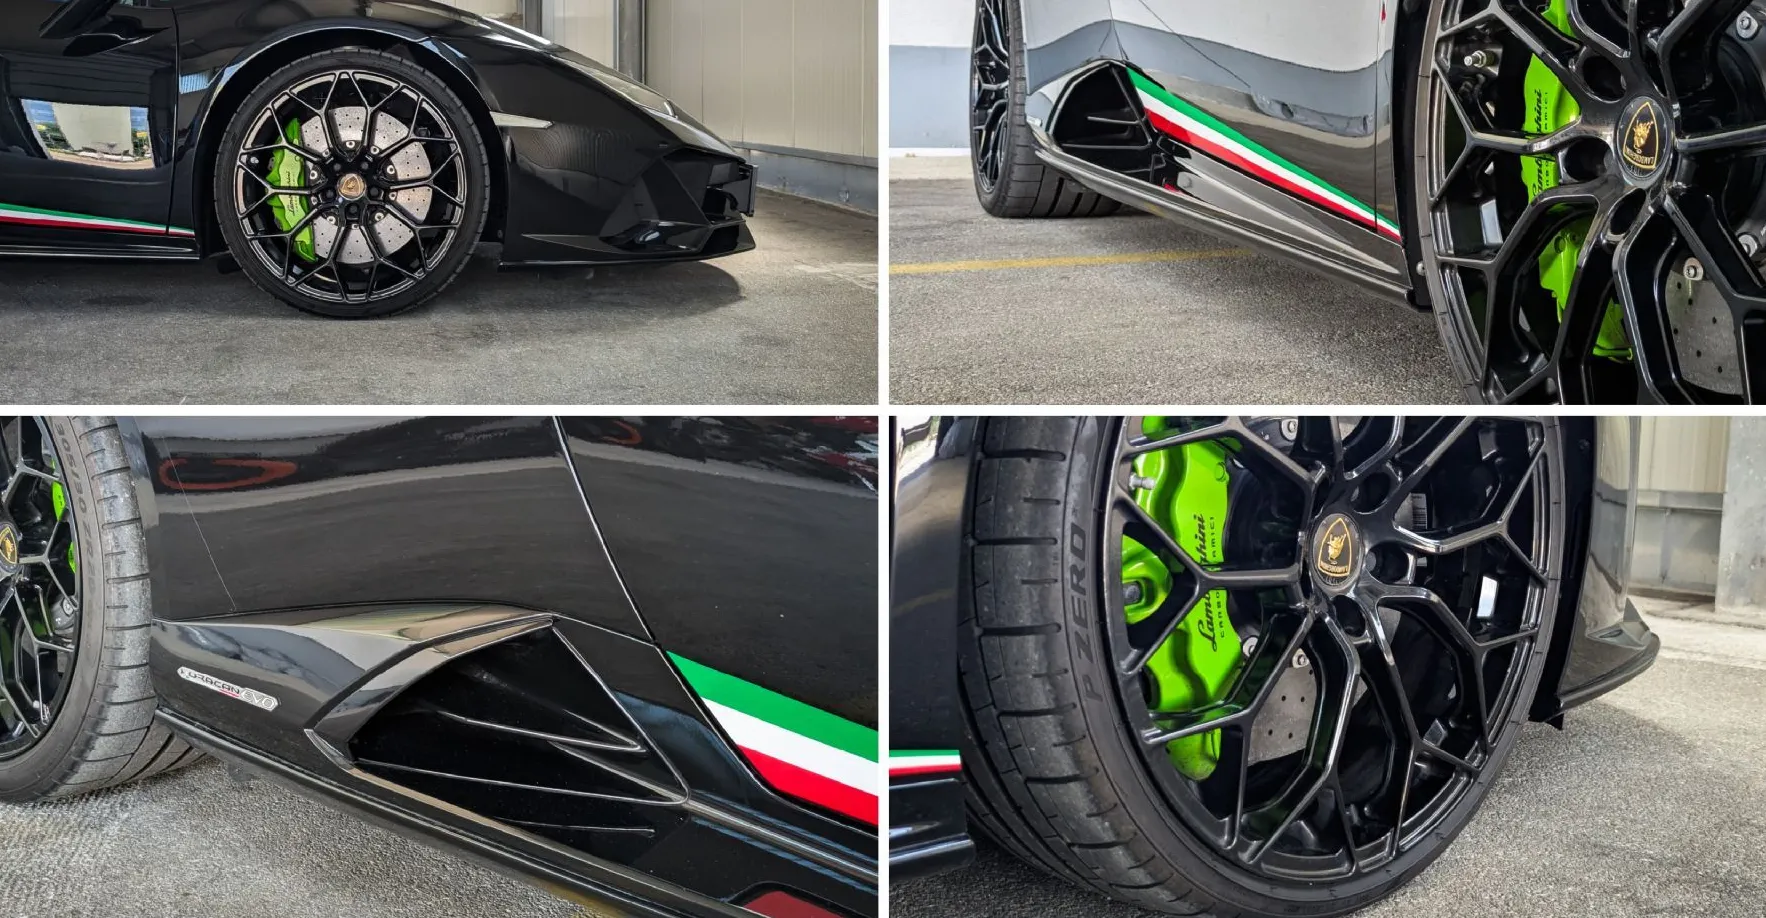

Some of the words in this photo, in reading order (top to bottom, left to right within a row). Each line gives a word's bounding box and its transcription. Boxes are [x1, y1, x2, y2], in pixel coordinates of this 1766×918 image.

[54, 422, 87, 514] 305/30
[1070, 522, 1094, 664] ZERO
[1193, 513, 1217, 652] Lambghini
[1210, 516, 1225, 639] CARBOAMICI
[240, 688, 275, 709] EVO
[1082, 674, 1103, 702] P
